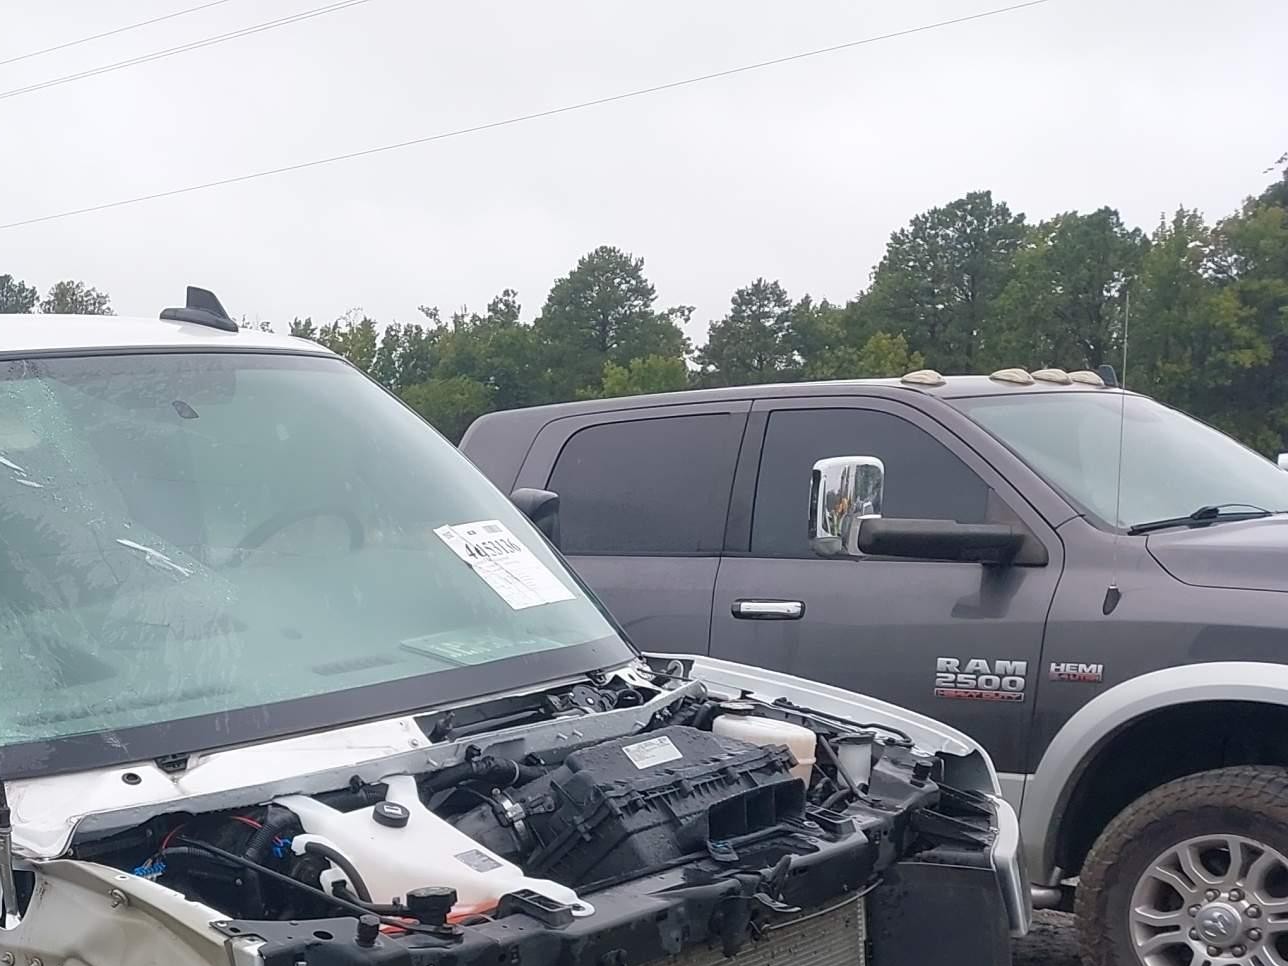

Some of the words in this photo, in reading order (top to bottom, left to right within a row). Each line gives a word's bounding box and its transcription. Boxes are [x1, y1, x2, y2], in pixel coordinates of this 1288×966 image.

[936, 657, 1027, 675] RAM
[1049, 662, 1103, 674] HEMI
[935, 673, 1025, 691] 2500
